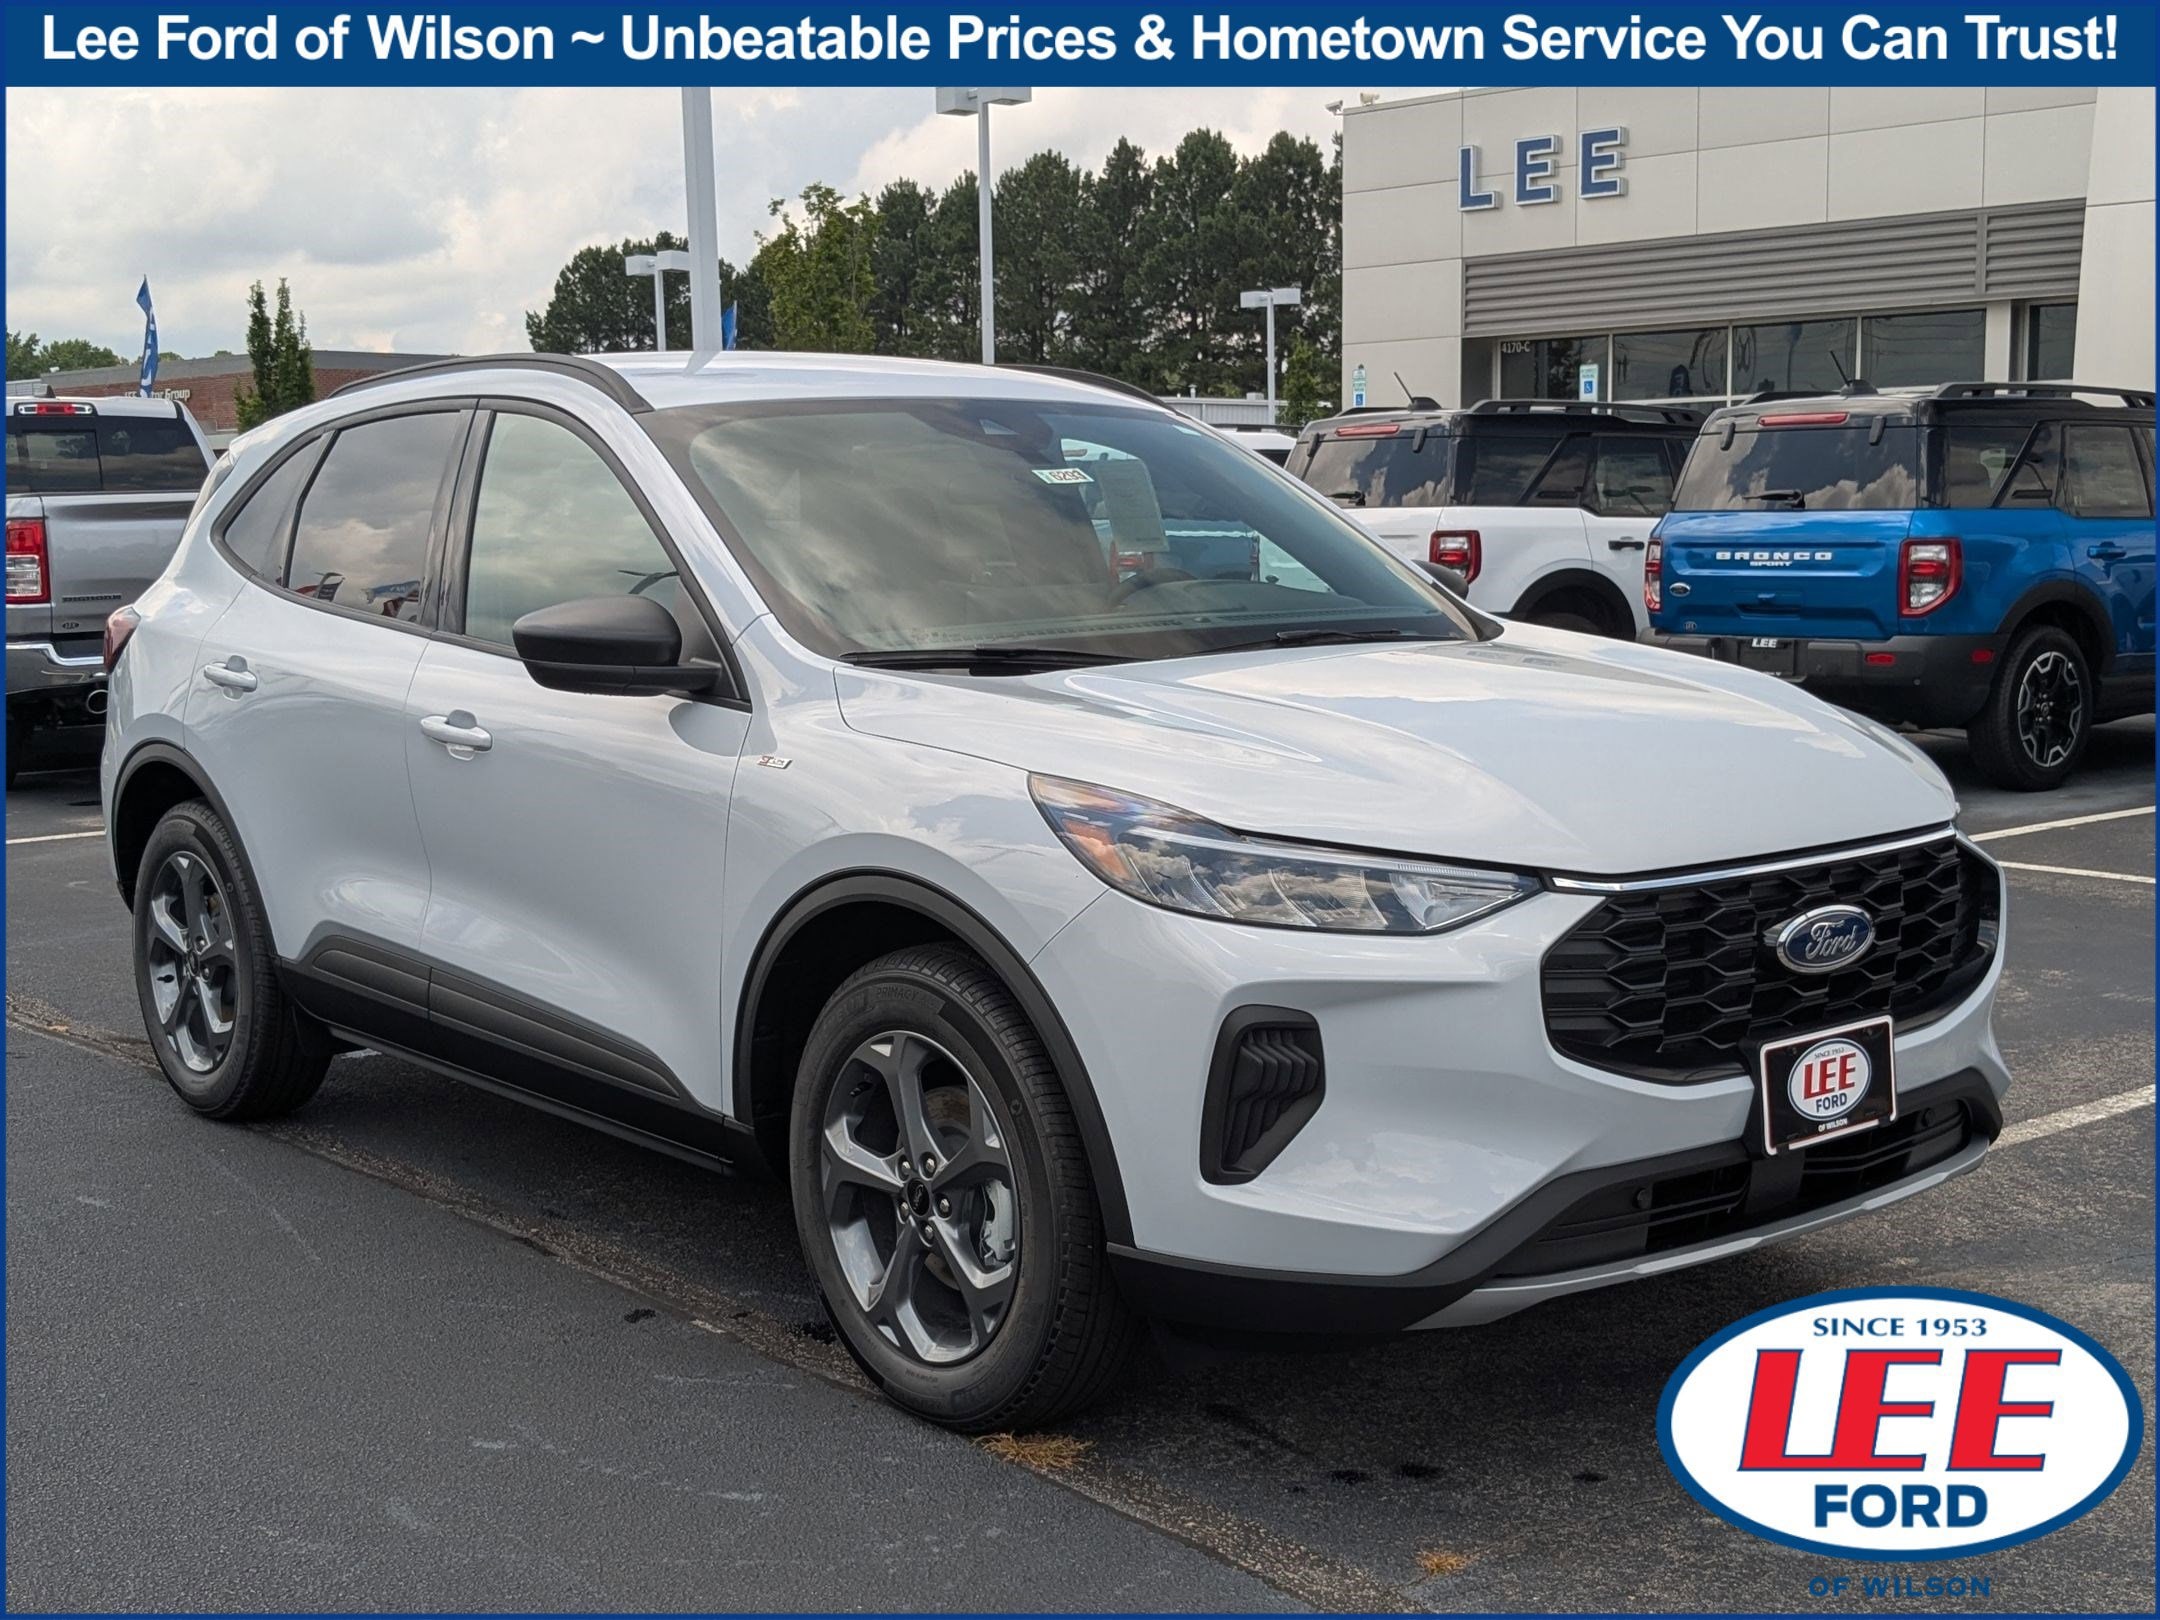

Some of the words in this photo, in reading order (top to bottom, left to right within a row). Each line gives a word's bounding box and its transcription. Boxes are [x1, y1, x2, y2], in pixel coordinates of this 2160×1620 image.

[1459, 127, 1628, 212] LEE
[1501, 341, 1531, 354] 4170-C
[164, 388, 191, 402] Group
[1715, 551, 1833, 561] BRONCO
[1751, 637, 1778, 649] LEE
[1805, 919, 1858, 960] Ford
[1803, 1051, 1857, 1100] LEE
[1815, 1092, 1848, 1113] FORD
[1826, 1117, 1848, 1130] WILSON
